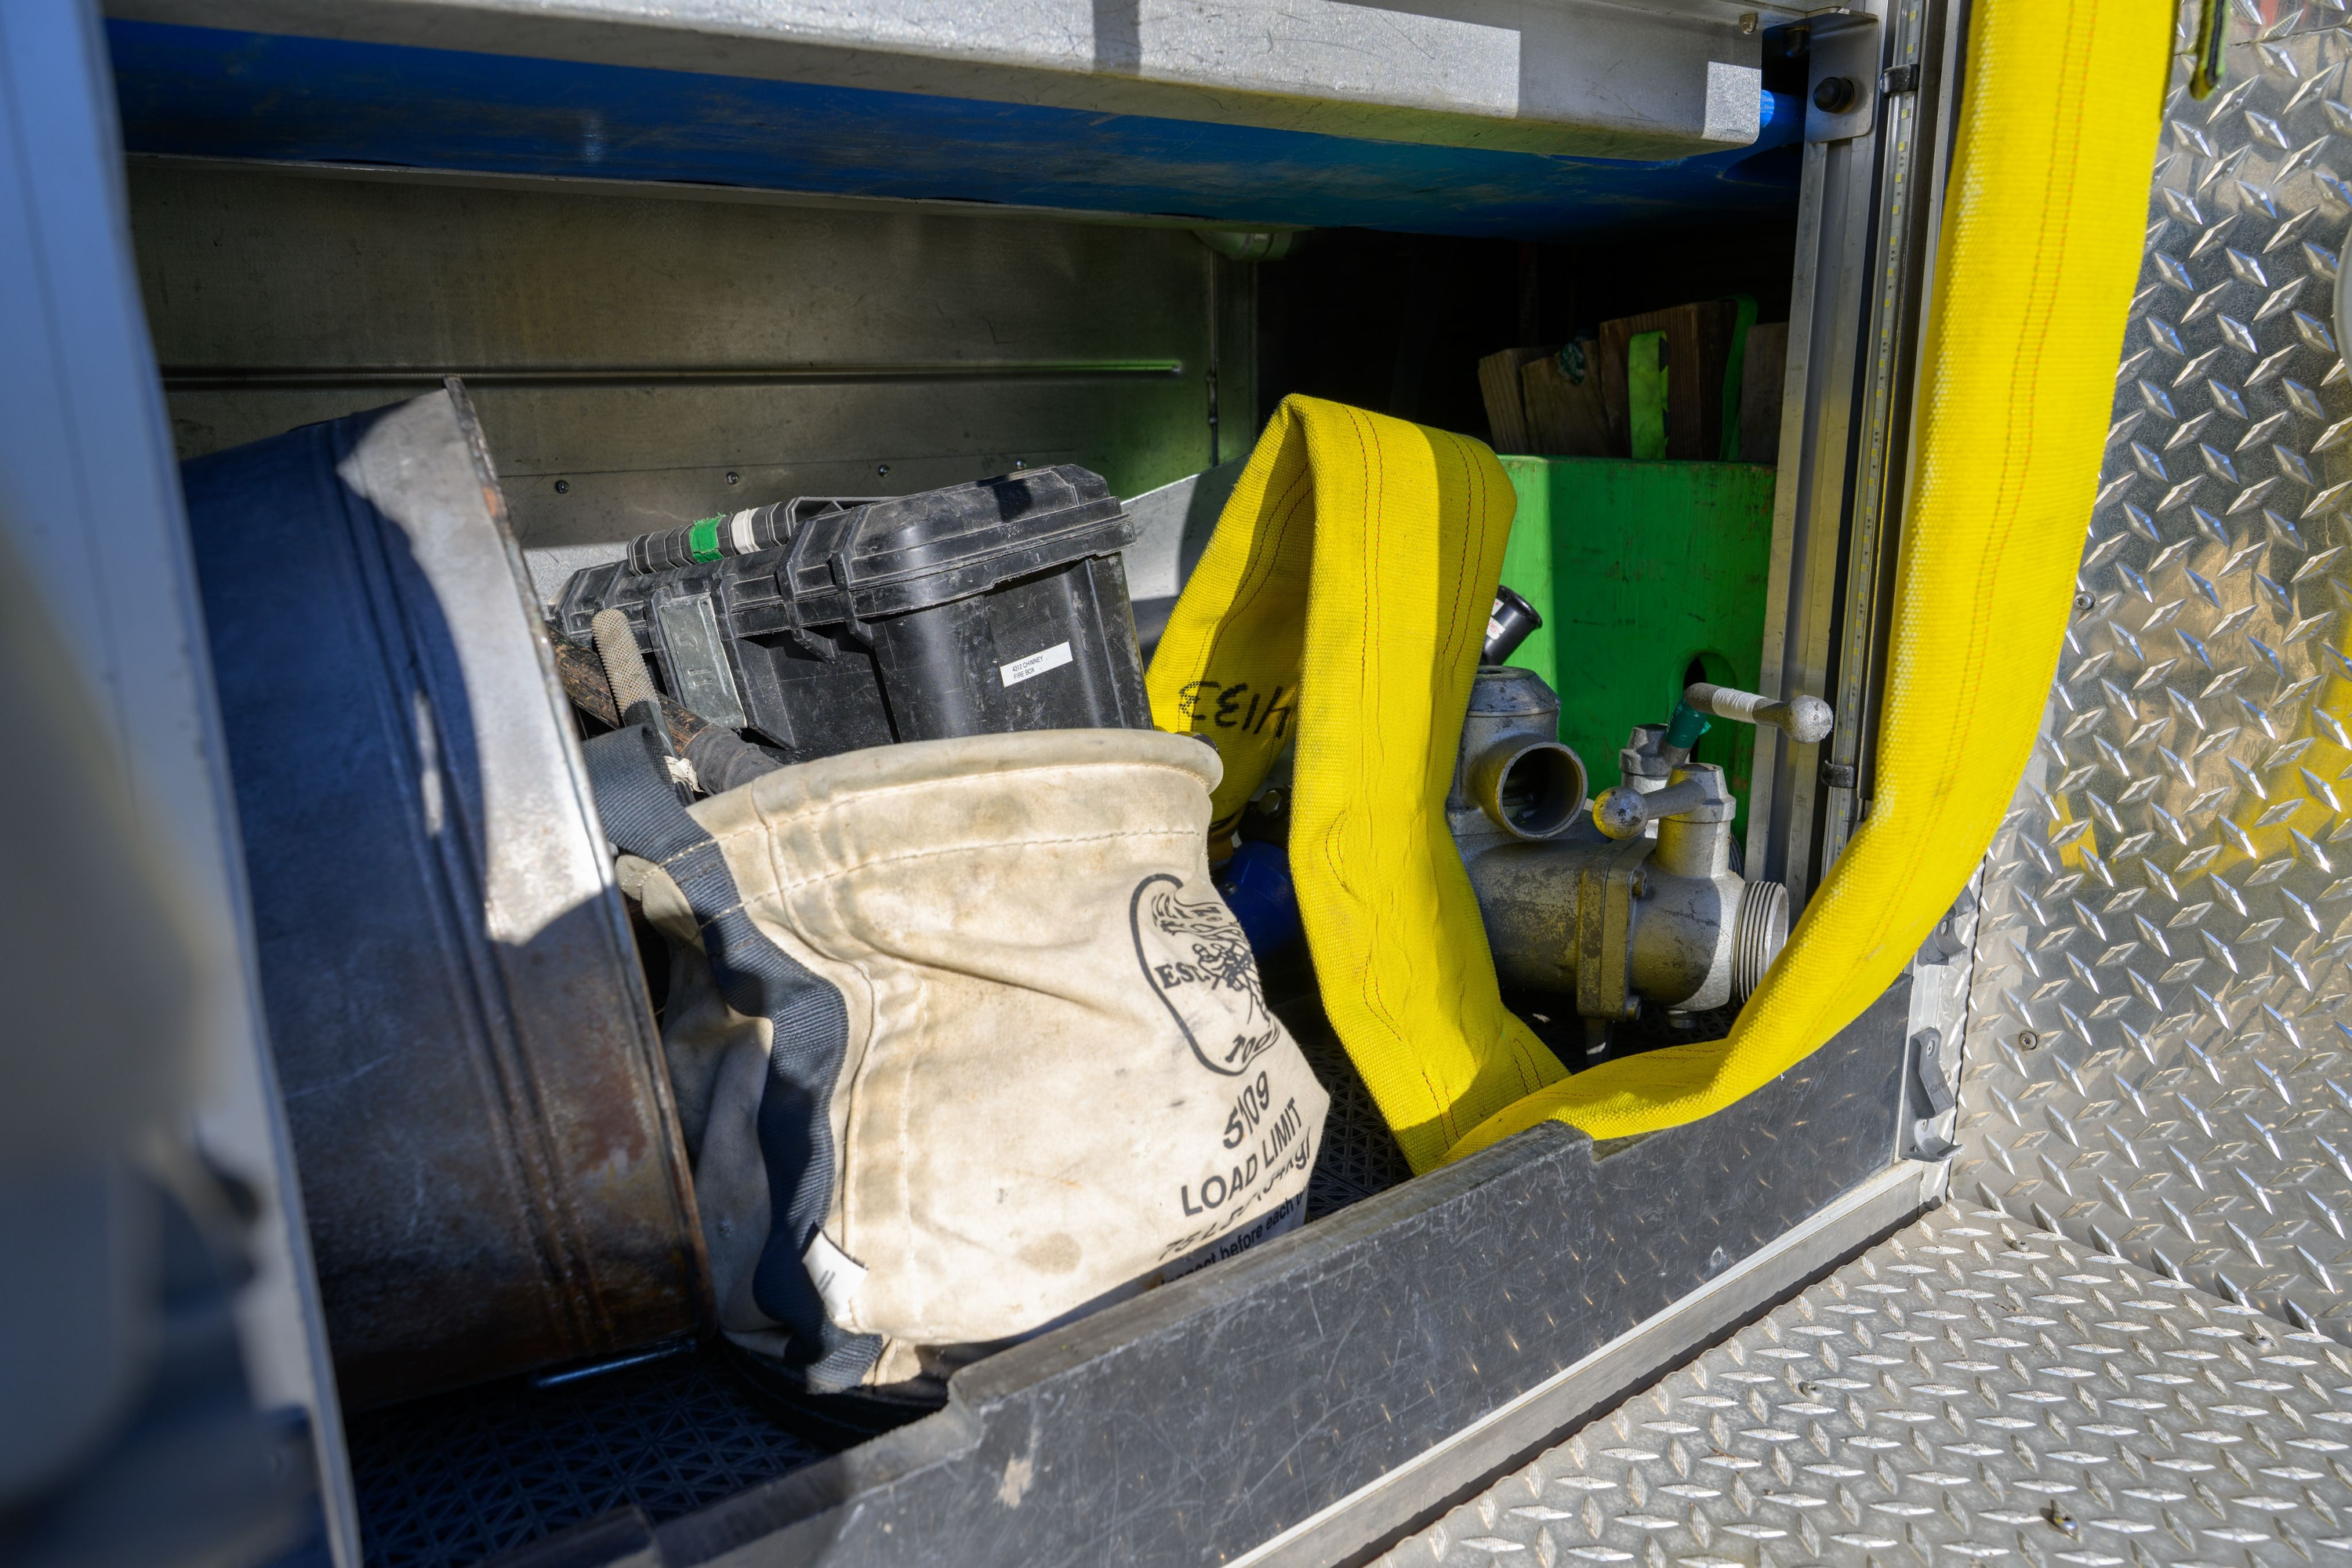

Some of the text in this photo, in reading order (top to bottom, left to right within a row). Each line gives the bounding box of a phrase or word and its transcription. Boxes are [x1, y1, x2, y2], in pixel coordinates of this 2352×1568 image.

[1013, 666, 1035, 680] FIRE BOX
[1022, 655, 1044, 669] CHIMNEY
[1222, 1070, 1269, 1149] 5109
[1181, 1097, 1302, 1217] LOAD LIMIT
[1220, 1197, 1294, 1261] before each
